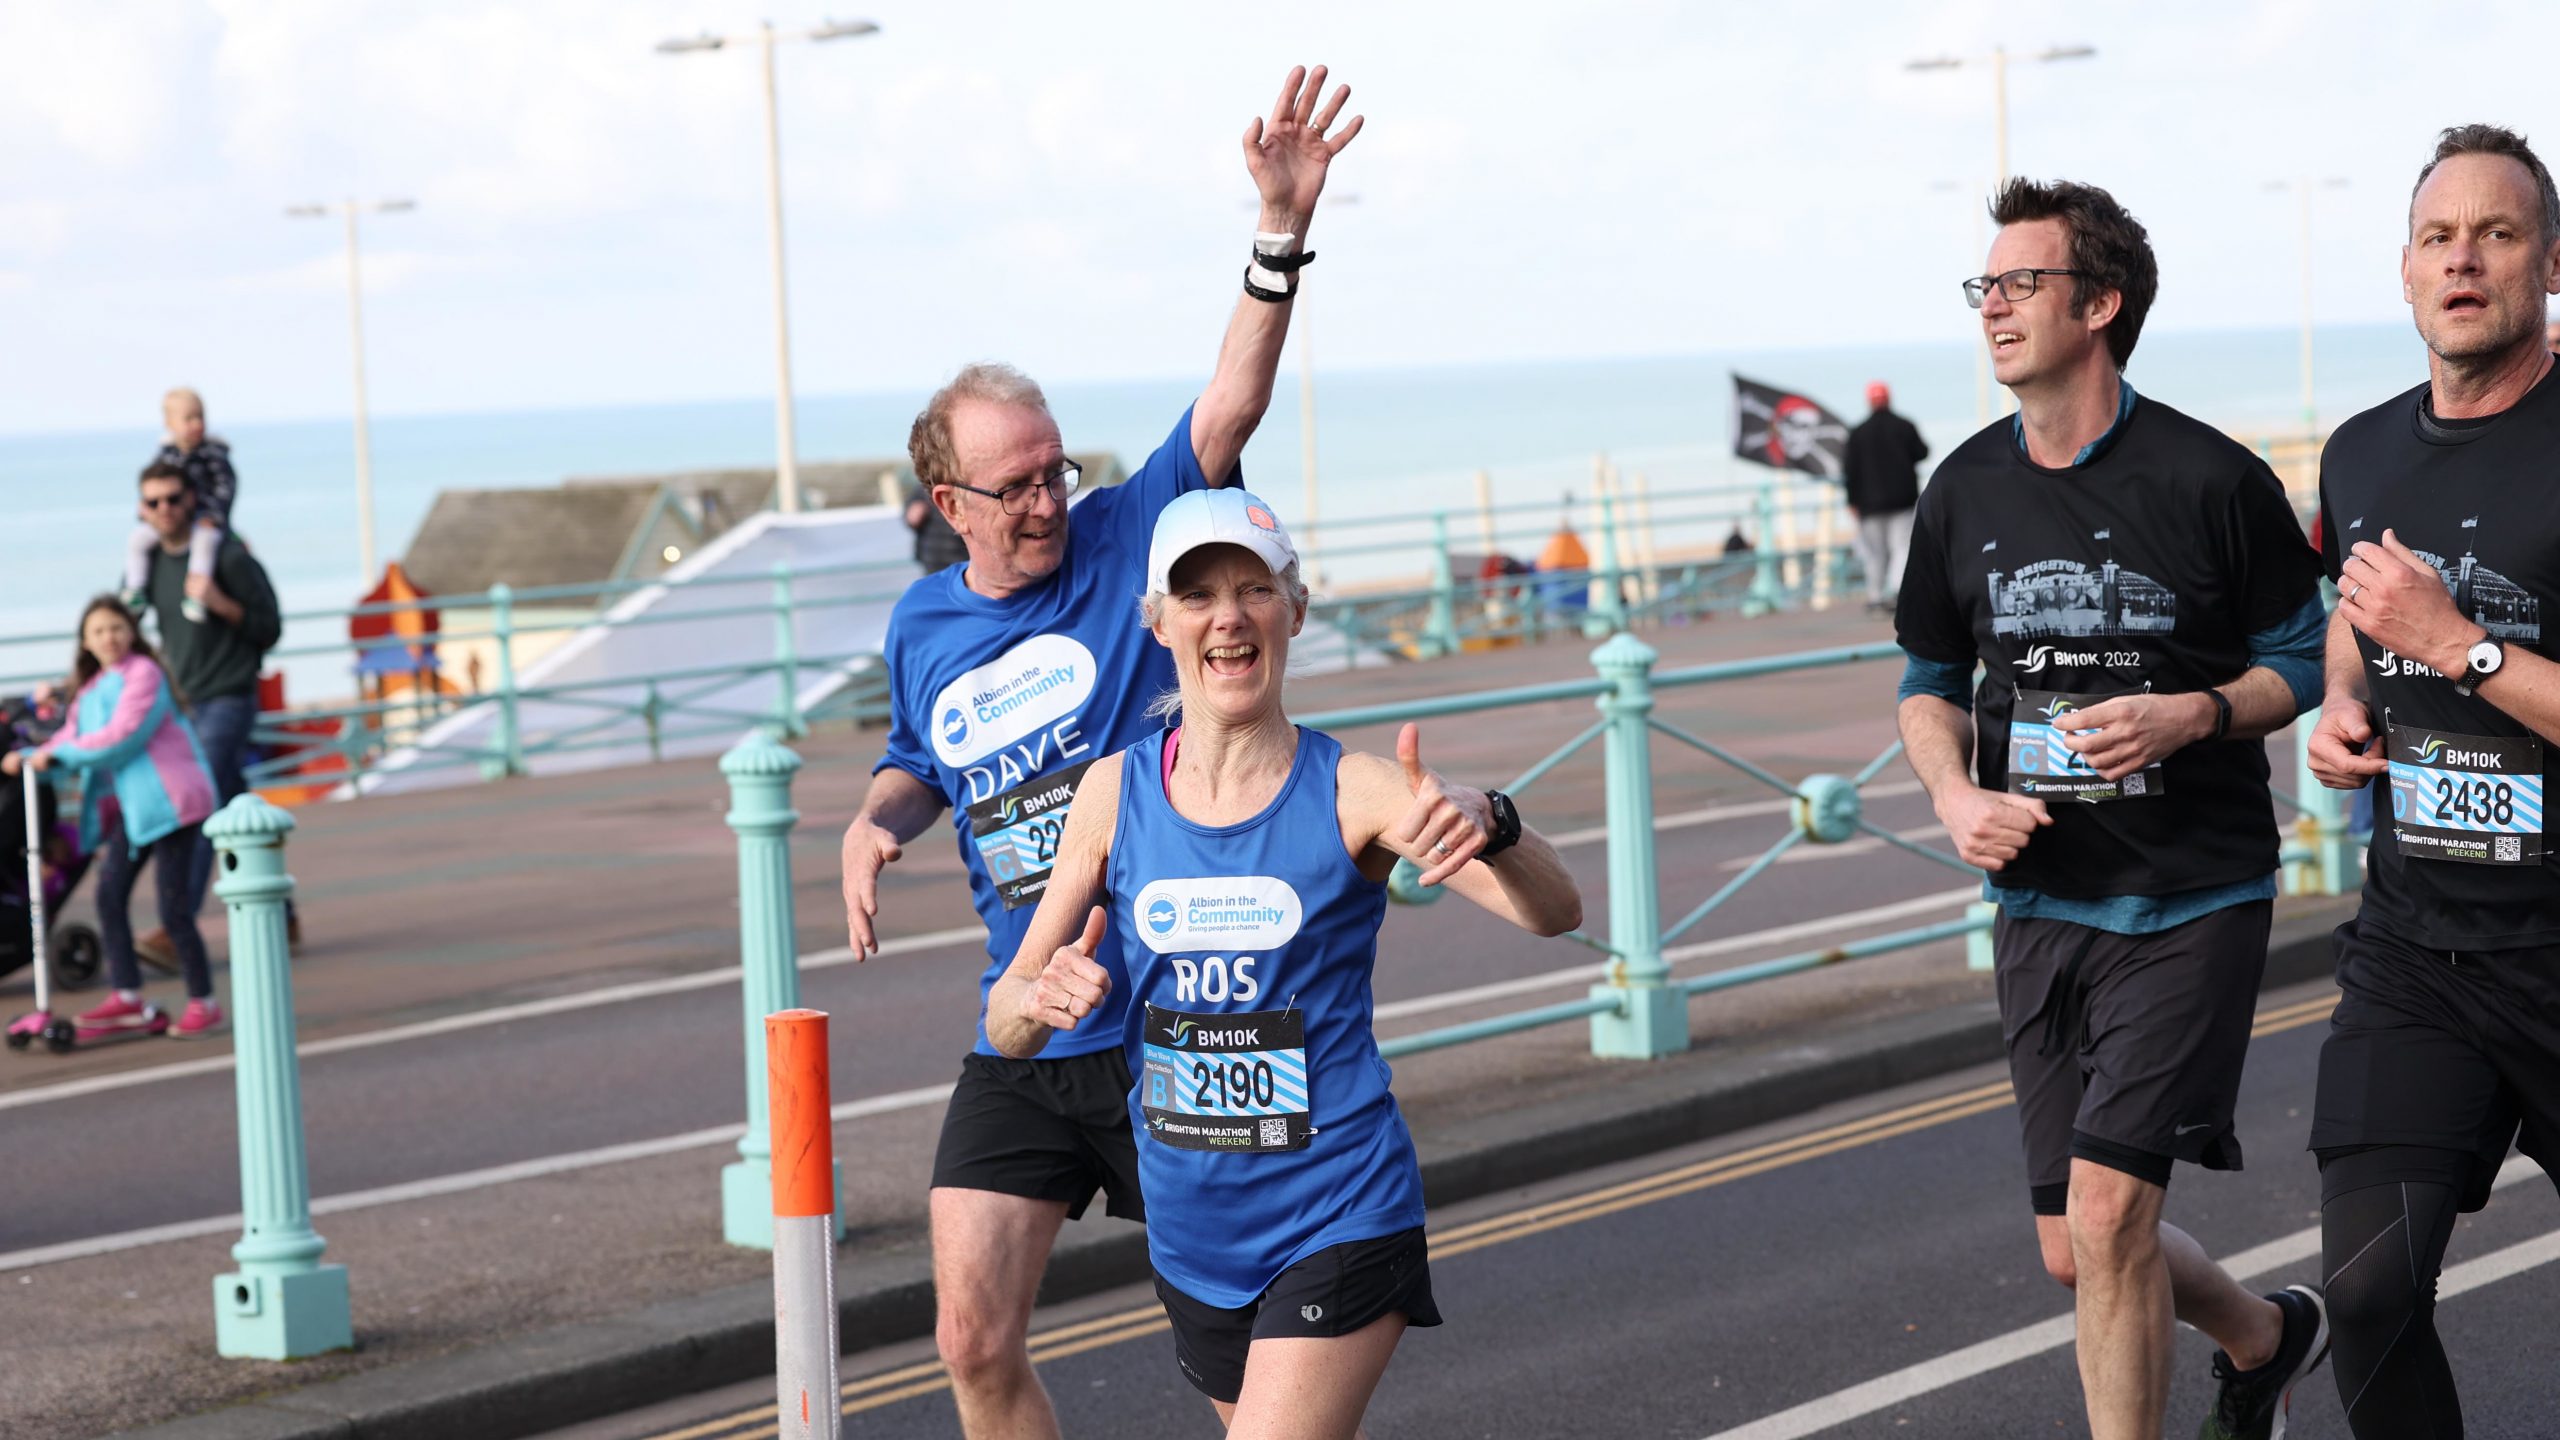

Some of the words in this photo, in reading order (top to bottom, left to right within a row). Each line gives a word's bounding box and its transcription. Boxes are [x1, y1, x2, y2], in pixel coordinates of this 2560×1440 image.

[2054, 650, 2101, 667] BM10K
[2105, 651, 2141, 668] 2022
[972, 684, 1011, 708] Albion
[1011, 677, 1023, 689] in
[1022, 666, 1041, 683] the
[977, 665, 1076, 724] Community
[962, 716, 1090, 804] DAVE
[2018, 745, 2039, 773] C
[2446, 749, 2502, 769] BM10K
[1023, 783, 1075, 814] BM10K
[2035, 783, 2072, 792] BRIGHTON
[2073, 782, 2117, 792] MARATHON
[2080, 790, 2117, 798] WEEKEND
[2393, 788, 2407, 819] D
[2436, 777, 2514, 826] 2438
[2401, 833, 2439, 846] BRIGHTON
[2440, 839, 2488, 850] MARATHON
[2447, 848, 2487, 859] WEEKEND
[994, 853, 1016, 881] C
[1188, 897, 1223, 908] Albion
[1225, 896, 1236, 906] in
[1238, 896, 1257, 906] the
[1188, 907, 1284, 925] Community
[1172, 957, 1258, 1003] ROS
[1197, 1029, 1260, 1047] BM10K
[1151, 1073, 1168, 1107] B
[1193, 1060, 1274, 1109] 2190
[1165, 1122, 1200, 1135] BRIGHTON
[1202, 1127, 1251, 1137] MARATHON
[1209, 1137, 1252, 1146] WEEKEND
